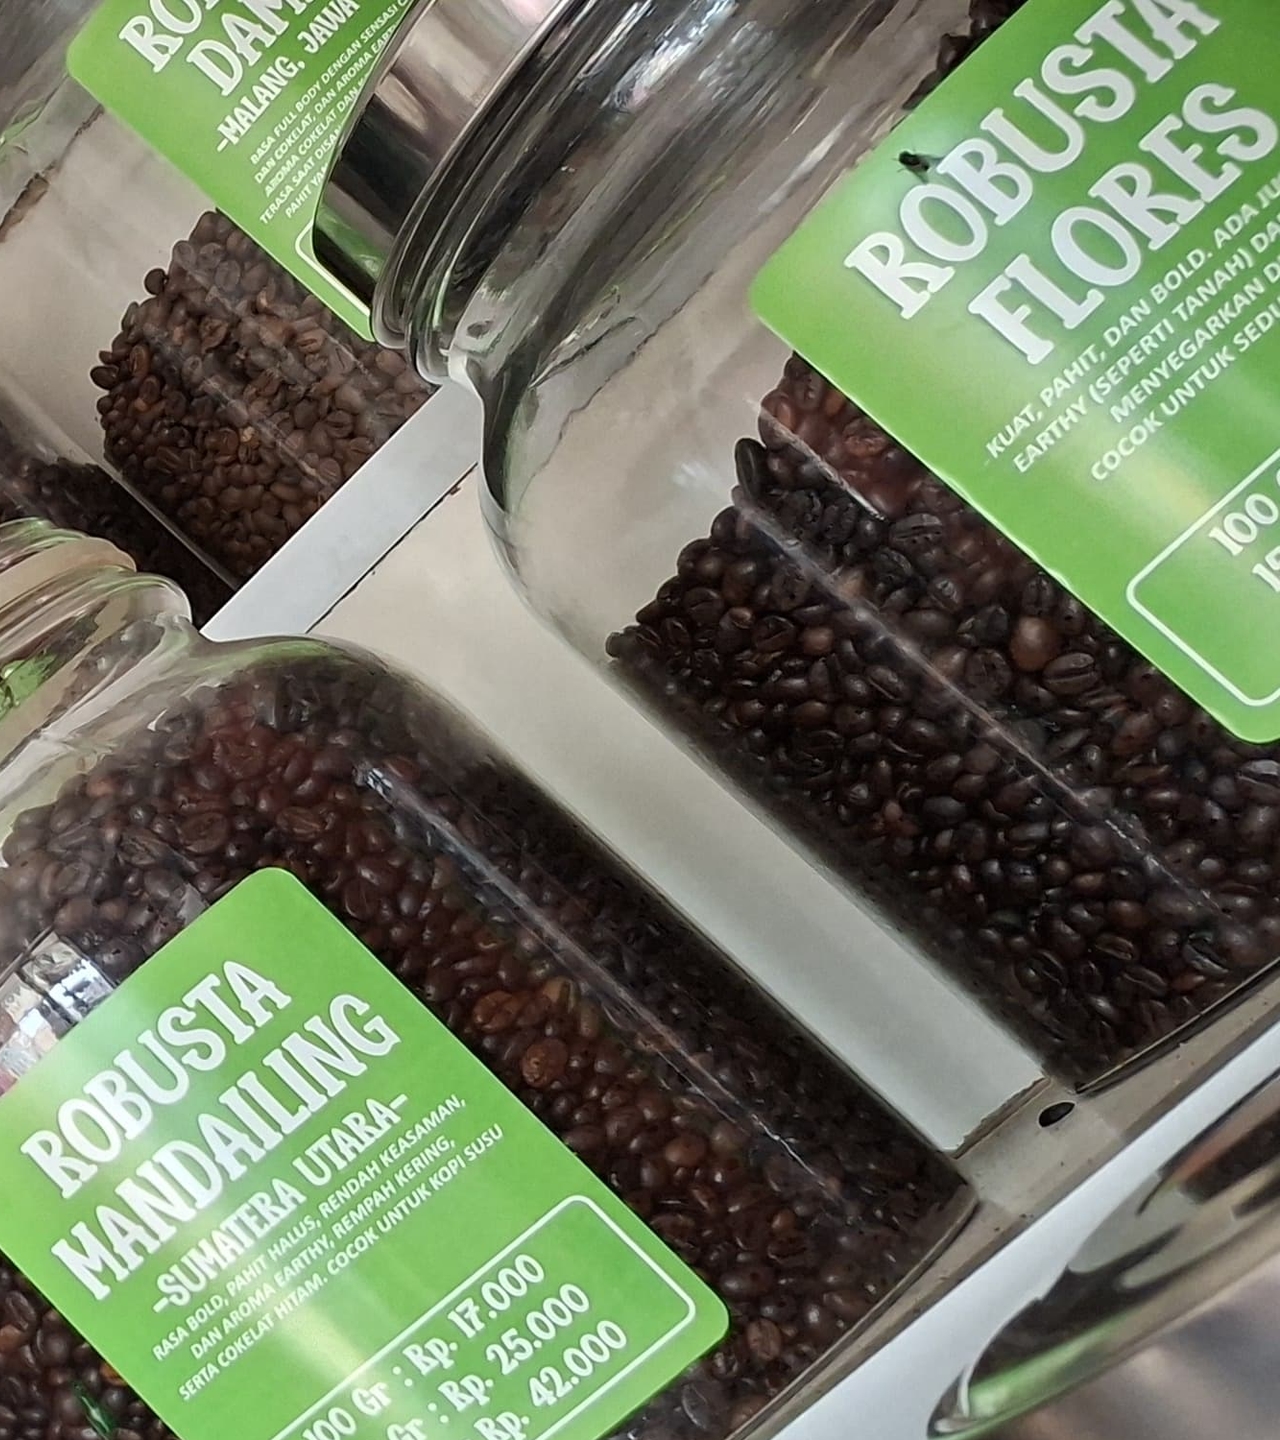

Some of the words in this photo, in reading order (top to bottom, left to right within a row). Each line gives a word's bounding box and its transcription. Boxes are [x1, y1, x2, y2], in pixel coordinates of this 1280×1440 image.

[119, 0, 218, 72] RO
[187, 0, 312, 96] DAM
[217, 56, 305, 151] -MALANG,
[297, 0, 360, 54] JAWA
[273, 111, 298, 138] FULL
[295, 81, 321, 113] BODY
[320, 39, 362, 85] DENGAN
[360, 0, 404, 43] SENSASI
[254, 156, 277, 184] DAN
[274, 113, 316, 161] COKELAT,
[314, 88, 337, 114] DAN
[336, 51, 373, 92] AROMA
[259, 185, 295, 224] TERASA
[291, 157, 315, 187] SAAT
[298, 108, 337, 156] COKELAT
[844, 0, 1222, 319] ROBUSTA
[285, 186, 312, 218] PAHIT
[968, 83, 1278, 364] FLORES
[986, 403, 1044, 458] KUAT,
[1039, 344, 1105, 408] PAHIT,
[1103, 298, 1151, 348] DAN
[1150, 248, 1213, 305] BOLD.
[1213, 204, 1259, 249] ADA
[1013, 394, 1088, 472] EARTHY
[1088, 318, 1174, 404] (SEPERTI
[1171, 248, 1254, 322] TANAH)
[1249, 213, 1280, 254] DA
[1106, 278, 1264, 424] MENYEGARKAN
[1262, 255, 1280, 285] D
[1091, 412, 1163, 480] COCOK
[1160, 345, 1235, 416] UNTUK
[1208, 493, 1279, 556] 100
[23, 963, 289, 1196] ROBUSTA
[55, 996, 396, 1297] MANDAILING
[152, 1326, 190, 1361] RASA
[186, 1294, 230, 1332] BOLD,
[226, 1254, 268, 1297] PAHIT
[266, 1215, 321, 1263] HALUS,
[318, 1160, 382, 1219] RENDAH
[379, 1095, 466, 1168] KEASAMAN,
[155, 1179, 306, 1311] -SUMATERA
[293, 1095, 407, 1186] UTARA-
[179, 1363, 220, 1401] SERTA
[217, 1309, 281, 1368] COKELAT
[269, 1273, 328, 1322] HITAM.
[326, 1227, 379, 1276] COCOK
[376, 1183, 432, 1233] UNTUK
[428, 1155, 466, 1191] KOPI
[463, 1124, 503, 1162] SUSU
[190, 1326, 223, 1360] DAN
[222, 1278, 281, 1334] AROMA
[269, 1234, 335, 1293] EARTHY,
[331, 1180, 397, 1240] REMPAH
[394, 1136, 455, 1187] KERING,
[351, 1382, 392, 1416] Gr
[402, 1338, 458, 1376] Rp.
[448, 1254, 544, 1338] 17.000
[437, 1374, 494, 1413] Rp.
[486, 1284, 590, 1375] 25.000
[529, 1320, 627, 1407] 42.000
